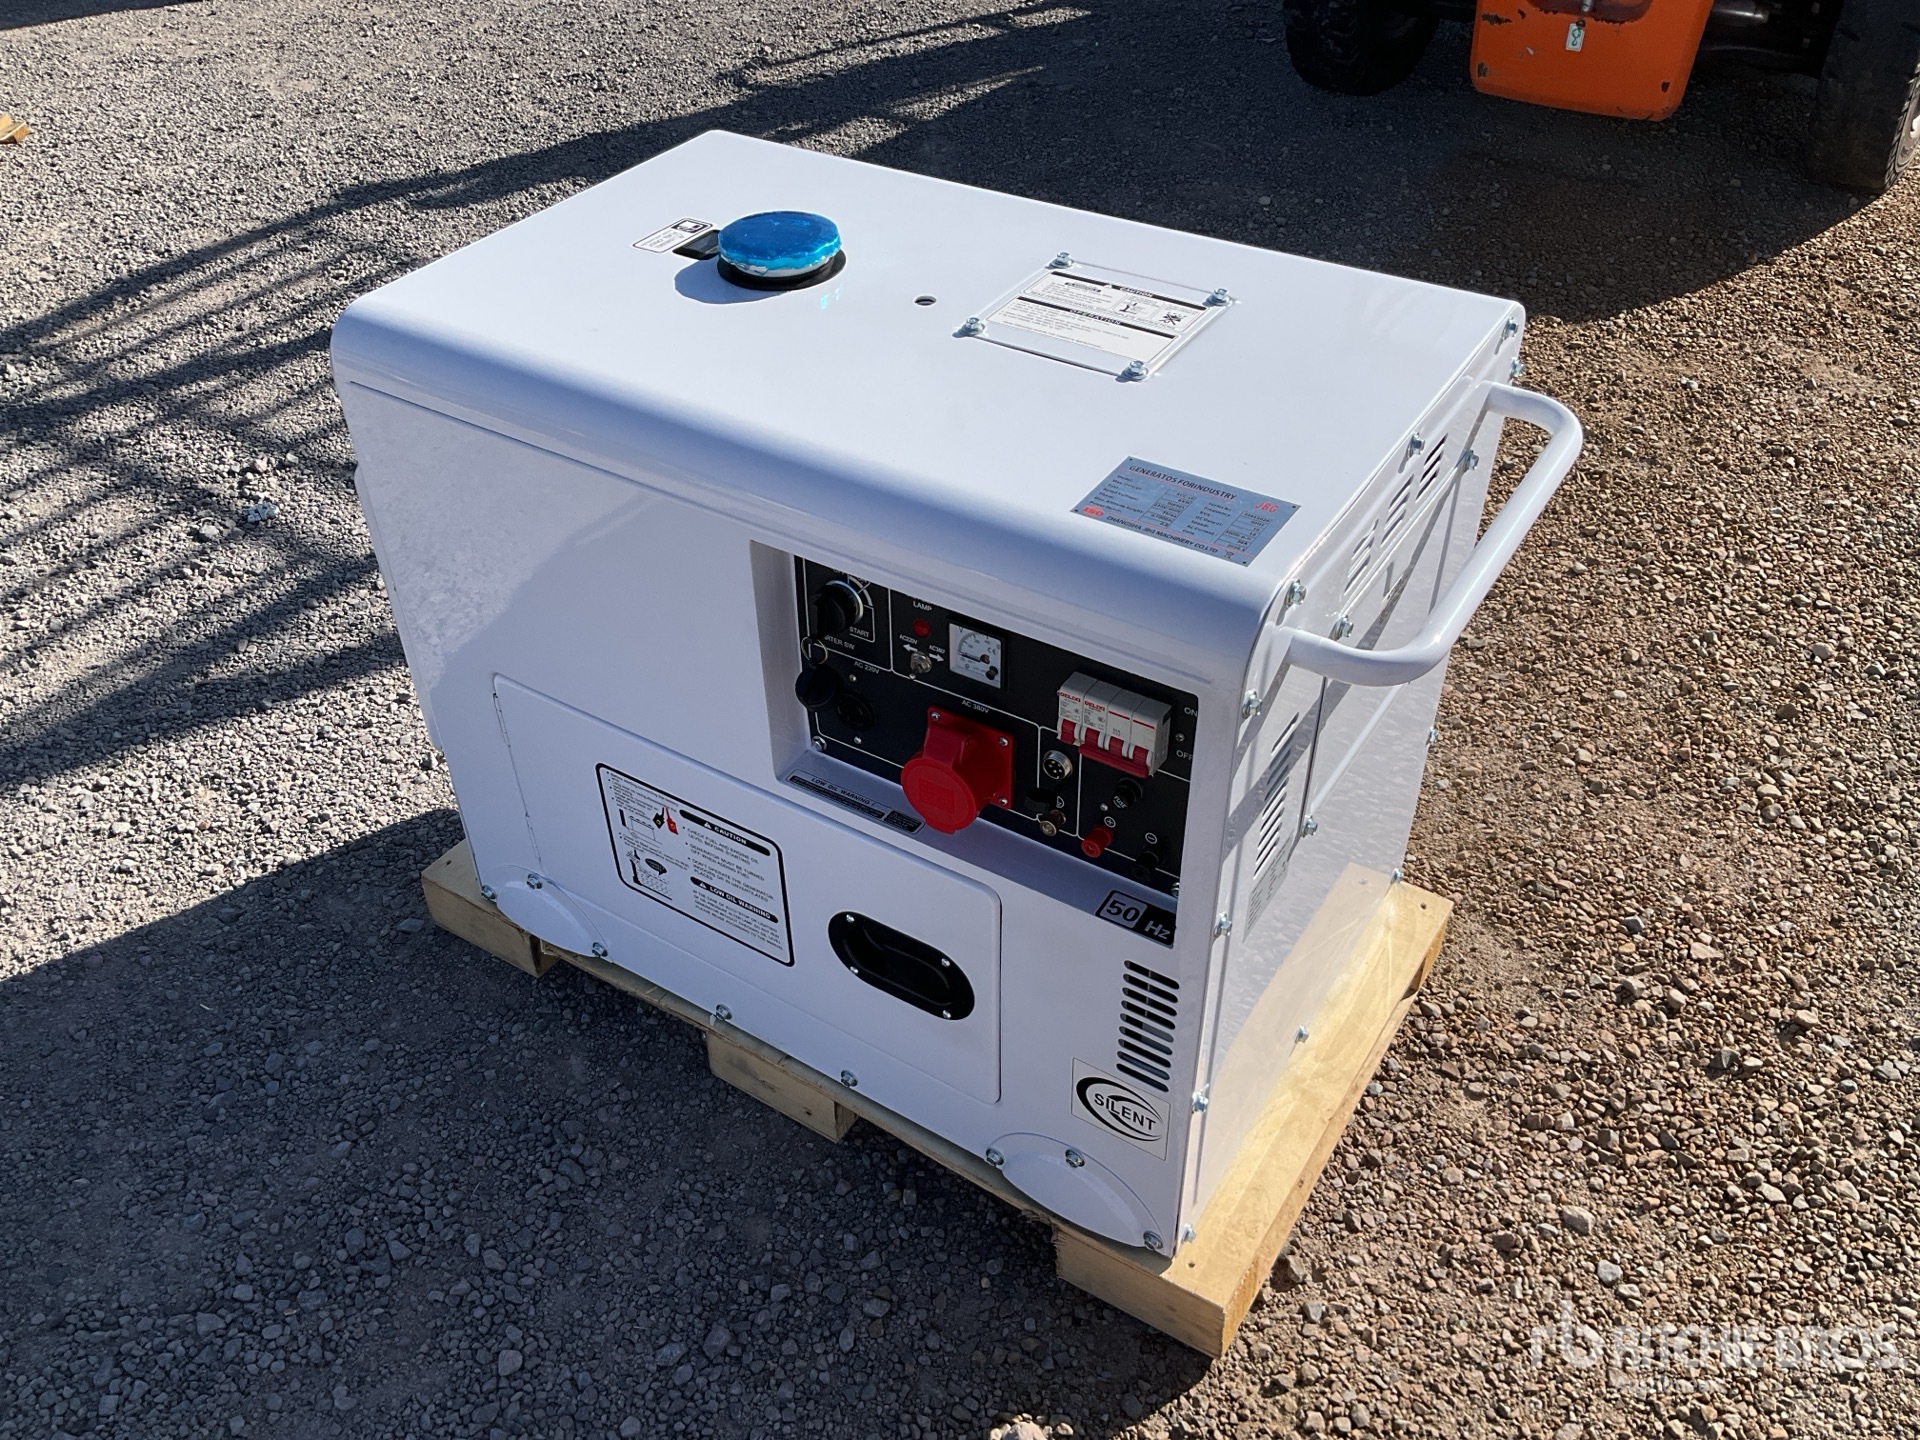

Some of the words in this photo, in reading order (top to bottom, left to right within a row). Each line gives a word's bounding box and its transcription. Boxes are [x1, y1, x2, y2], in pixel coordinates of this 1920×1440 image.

[1119, 286, 1154, 298] CAUTION
[1069, 309, 1122, 326] OPERATION
[1129, 465, 1179, 483] GENERATOS
[1177, 479, 1237, 500] FORINDUSTRY
[1255, 500, 1280, 513] JBG
[1106, 516, 1142, 530] CHANGSHA
[1155, 531, 1193, 545] MACHINERY
[913, 601, 933, 612] LAMP
[849, 626, 870, 638] START
[854, 660, 864, 669] AC
[961, 699, 971, 708] AC
[971, 702, 990, 714] 380V
[1184, 707, 1198, 717] ON
[811, 777, 826, 787] LOW
[827, 784, 838, 792] OIL
[840, 789, 870, 805] WARNING
[1114, 795, 1127, 809] FUSE
[715, 826, 746, 845] CAUTION
[710, 886, 724, 897] LOW
[726, 894, 737, 903] OIL
[738, 900, 770, 919] WARNING
[1106, 899, 1141, 923] 50
[1144, 920, 1171, 940] Hz
[1093, 1092, 1157, 1132] SILENT
